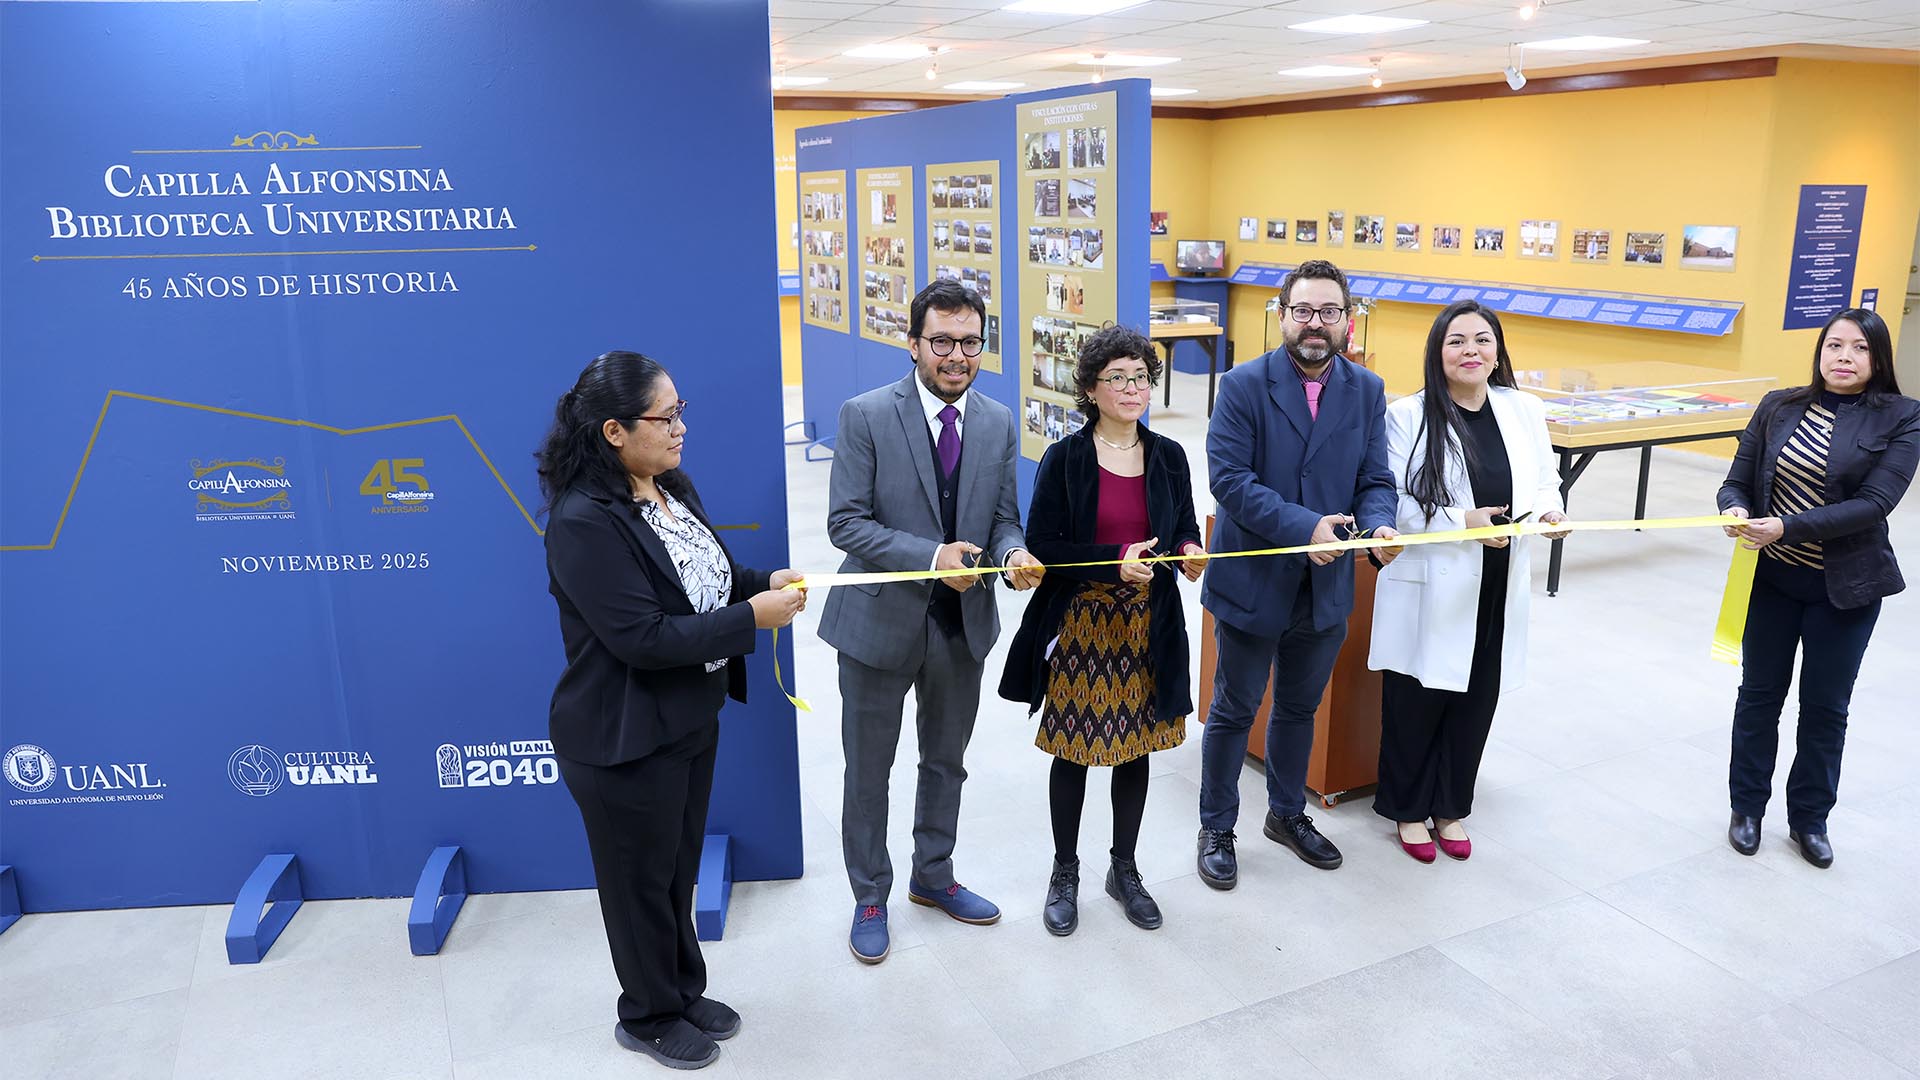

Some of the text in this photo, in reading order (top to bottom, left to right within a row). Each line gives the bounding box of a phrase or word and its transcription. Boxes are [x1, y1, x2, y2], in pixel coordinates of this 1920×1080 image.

[104, 162, 454, 198] CAPILLA ALFONSINA
[46, 203, 517, 239] BIBLIOTECA UNIVERSITARIA
[122, 271, 459, 299] 45 AÑOS DE HISTORIA
[360, 458, 430, 505] 45
[371, 505, 429, 514] ANIVERSARIO
[220, 552, 430, 573] NOVIEMBRE 2025
[284, 751, 375, 766] CULTURA
[464, 741, 553, 758] VISIÓN UANL
[286, 764, 378, 786] UANL
[466, 757, 559, 787] 2040
[9, 798, 61, 806] UNIVERSIDAD
[144, 793, 164, 801] LEÓN
